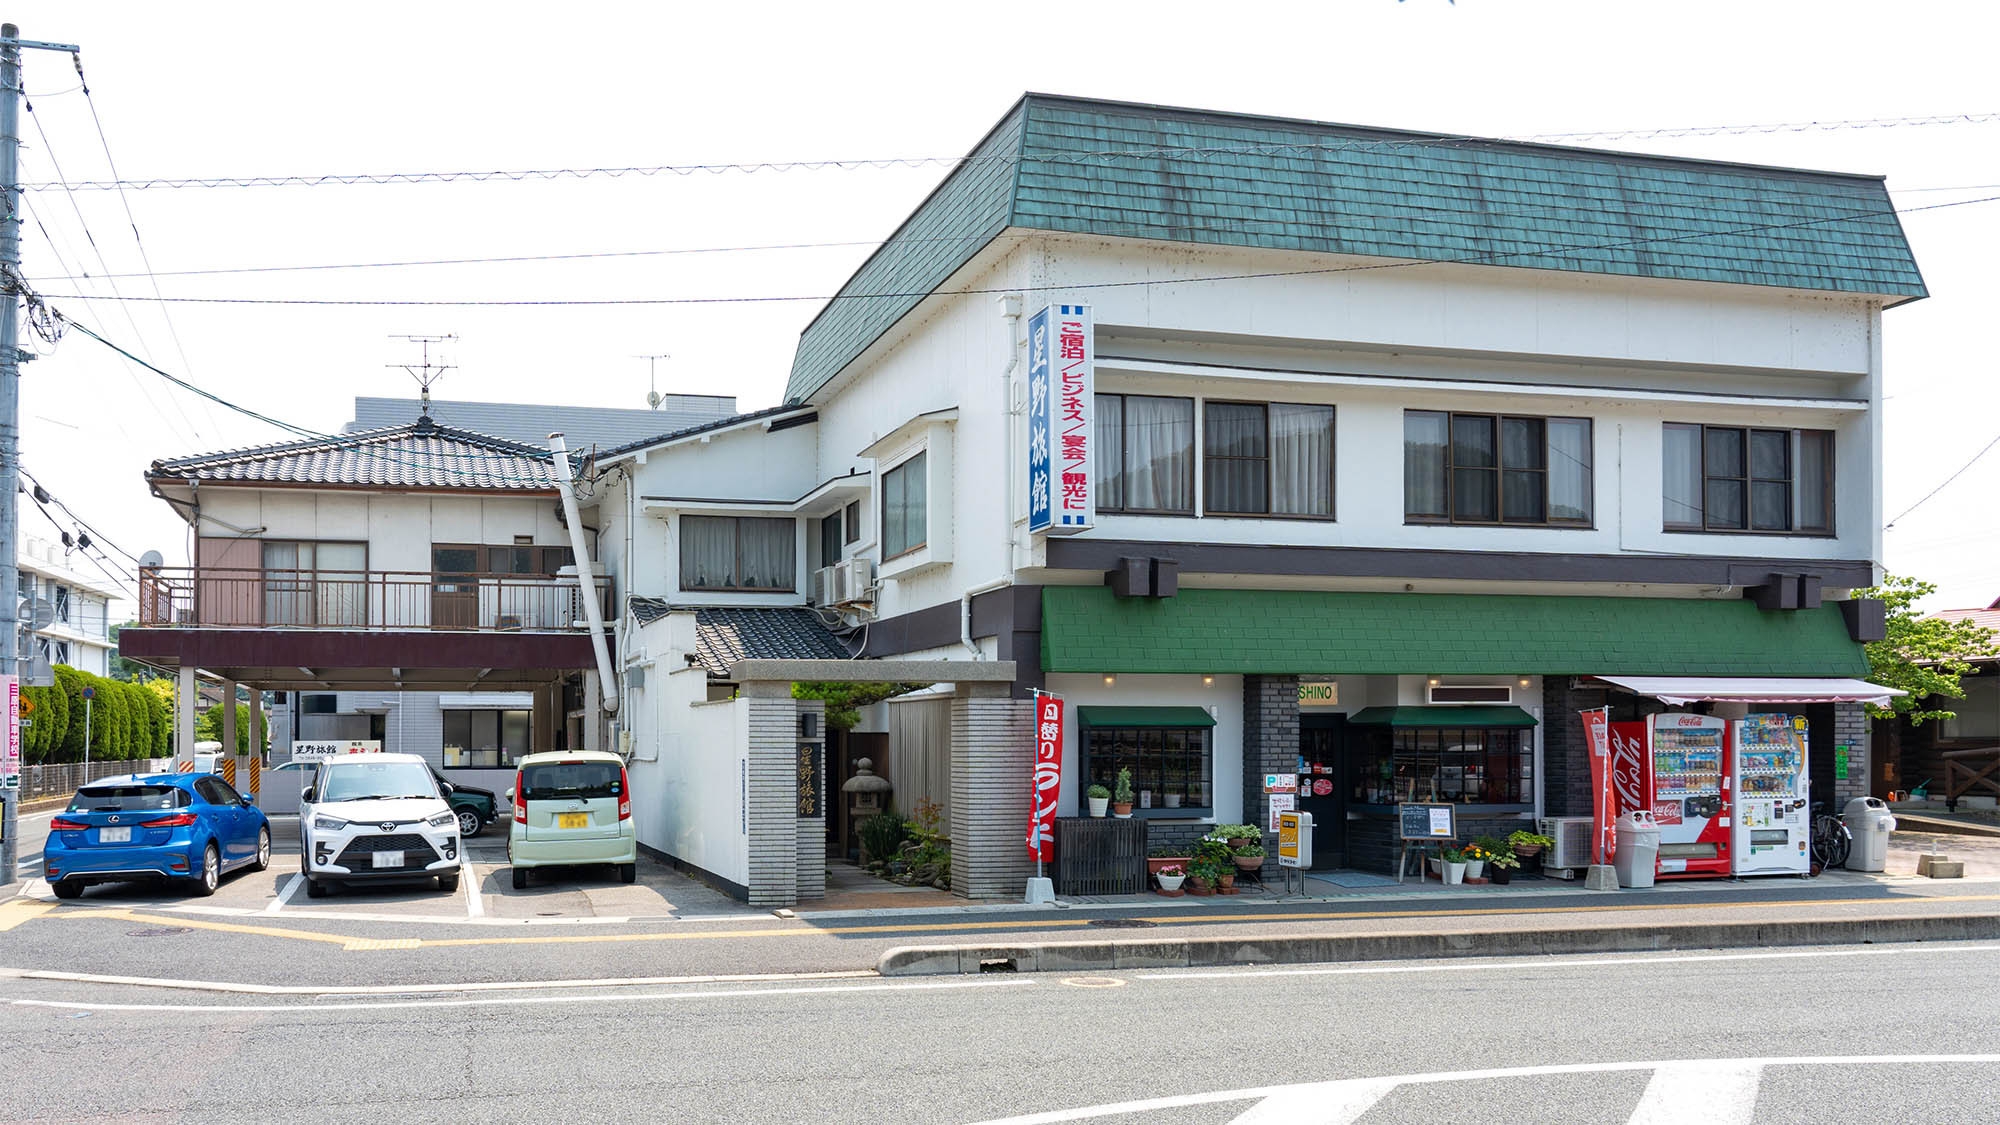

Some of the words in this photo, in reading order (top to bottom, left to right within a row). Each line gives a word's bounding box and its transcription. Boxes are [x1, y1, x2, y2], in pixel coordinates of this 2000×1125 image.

[1030, 324, 1048, 517] 星野旅館
[1298, 685, 1332, 700] SHINO
[1678, 716, 1703, 727] Coca-Cola
[295, 744, 337, 755] 星野旅館
[799, 746, 816, 815] 星野旅館
